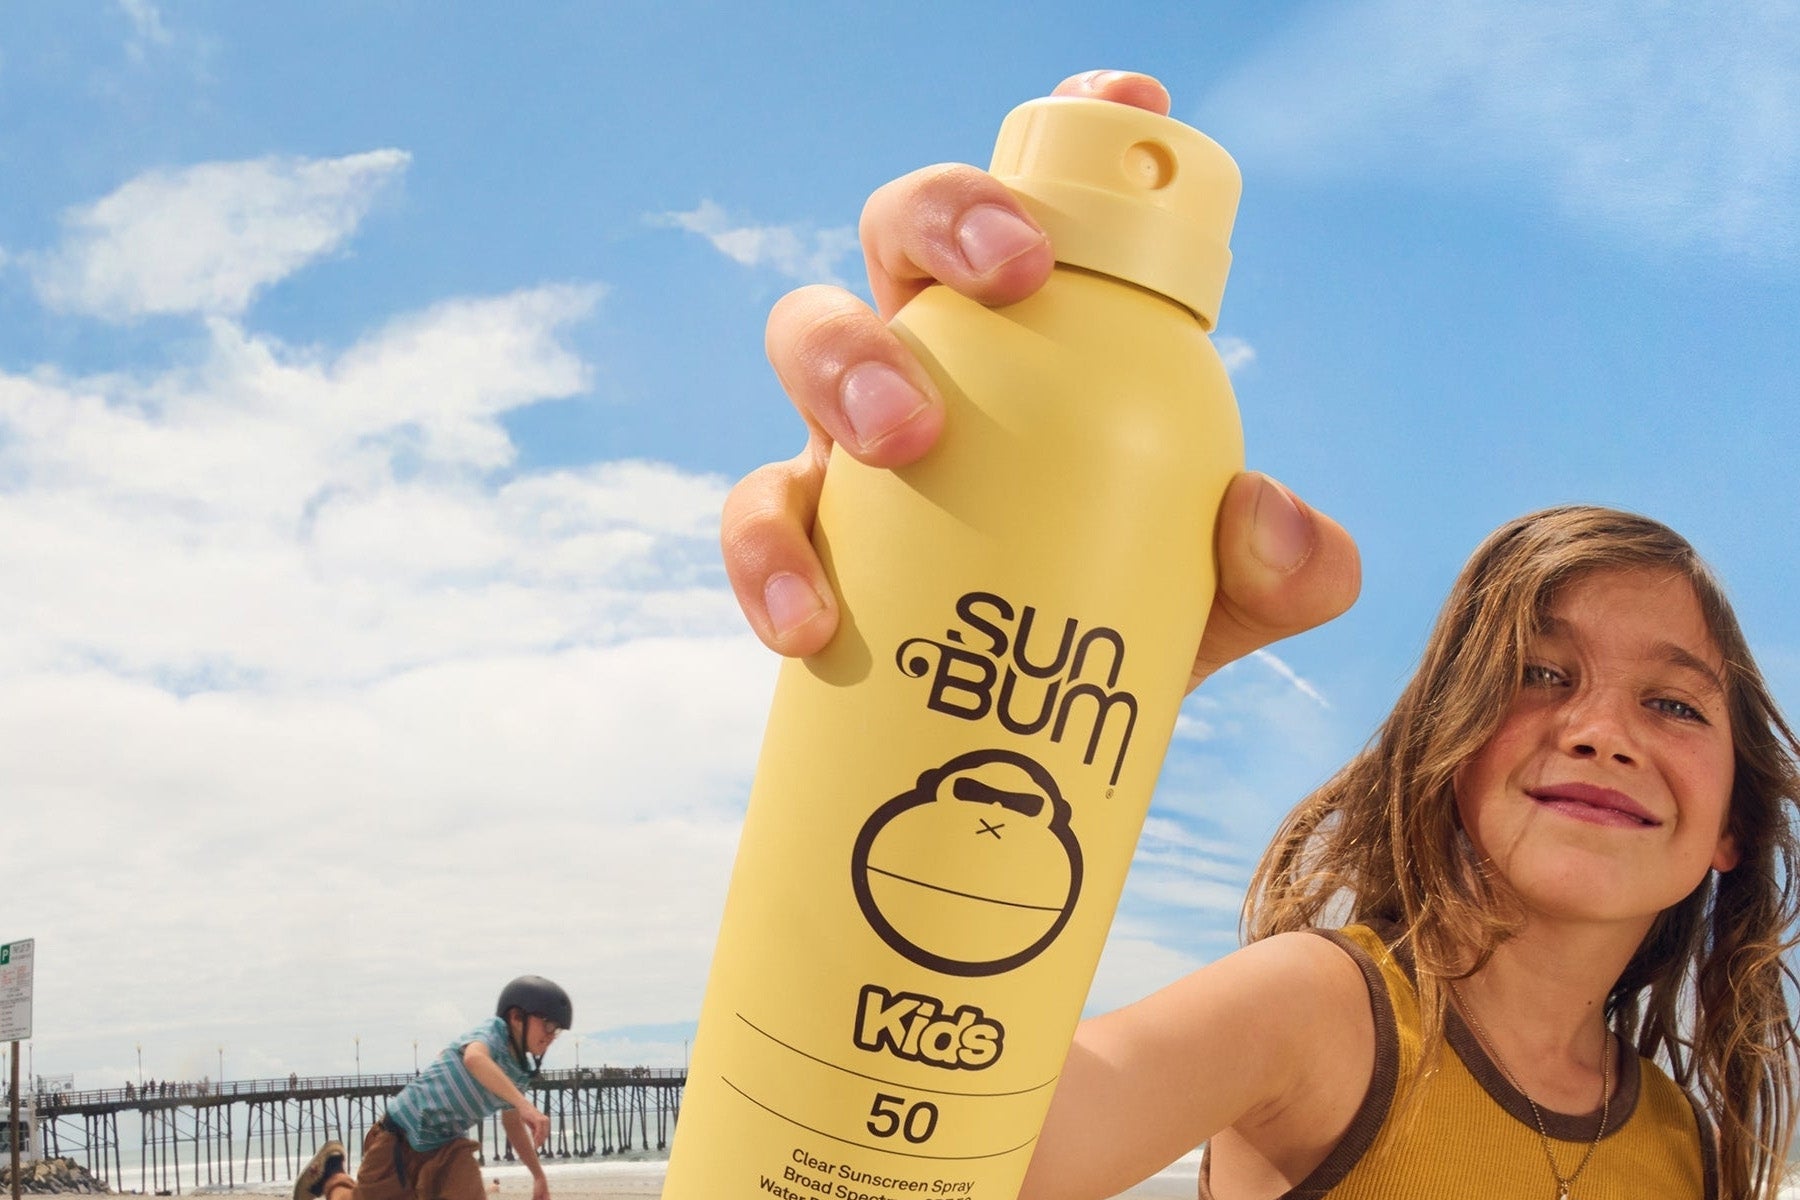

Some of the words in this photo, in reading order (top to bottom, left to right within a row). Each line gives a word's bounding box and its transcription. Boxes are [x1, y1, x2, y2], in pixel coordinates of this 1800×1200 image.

[853, 983, 1005, 1071] Kids
[866, 1092, 939, 1144] 50
[783, 1166, 833, 1195] Broad
[792, 1148, 836, 1174] Clear
[838, 1165, 928, 1193] Sunscreen
[931, 1179, 975, 1196] Spray
